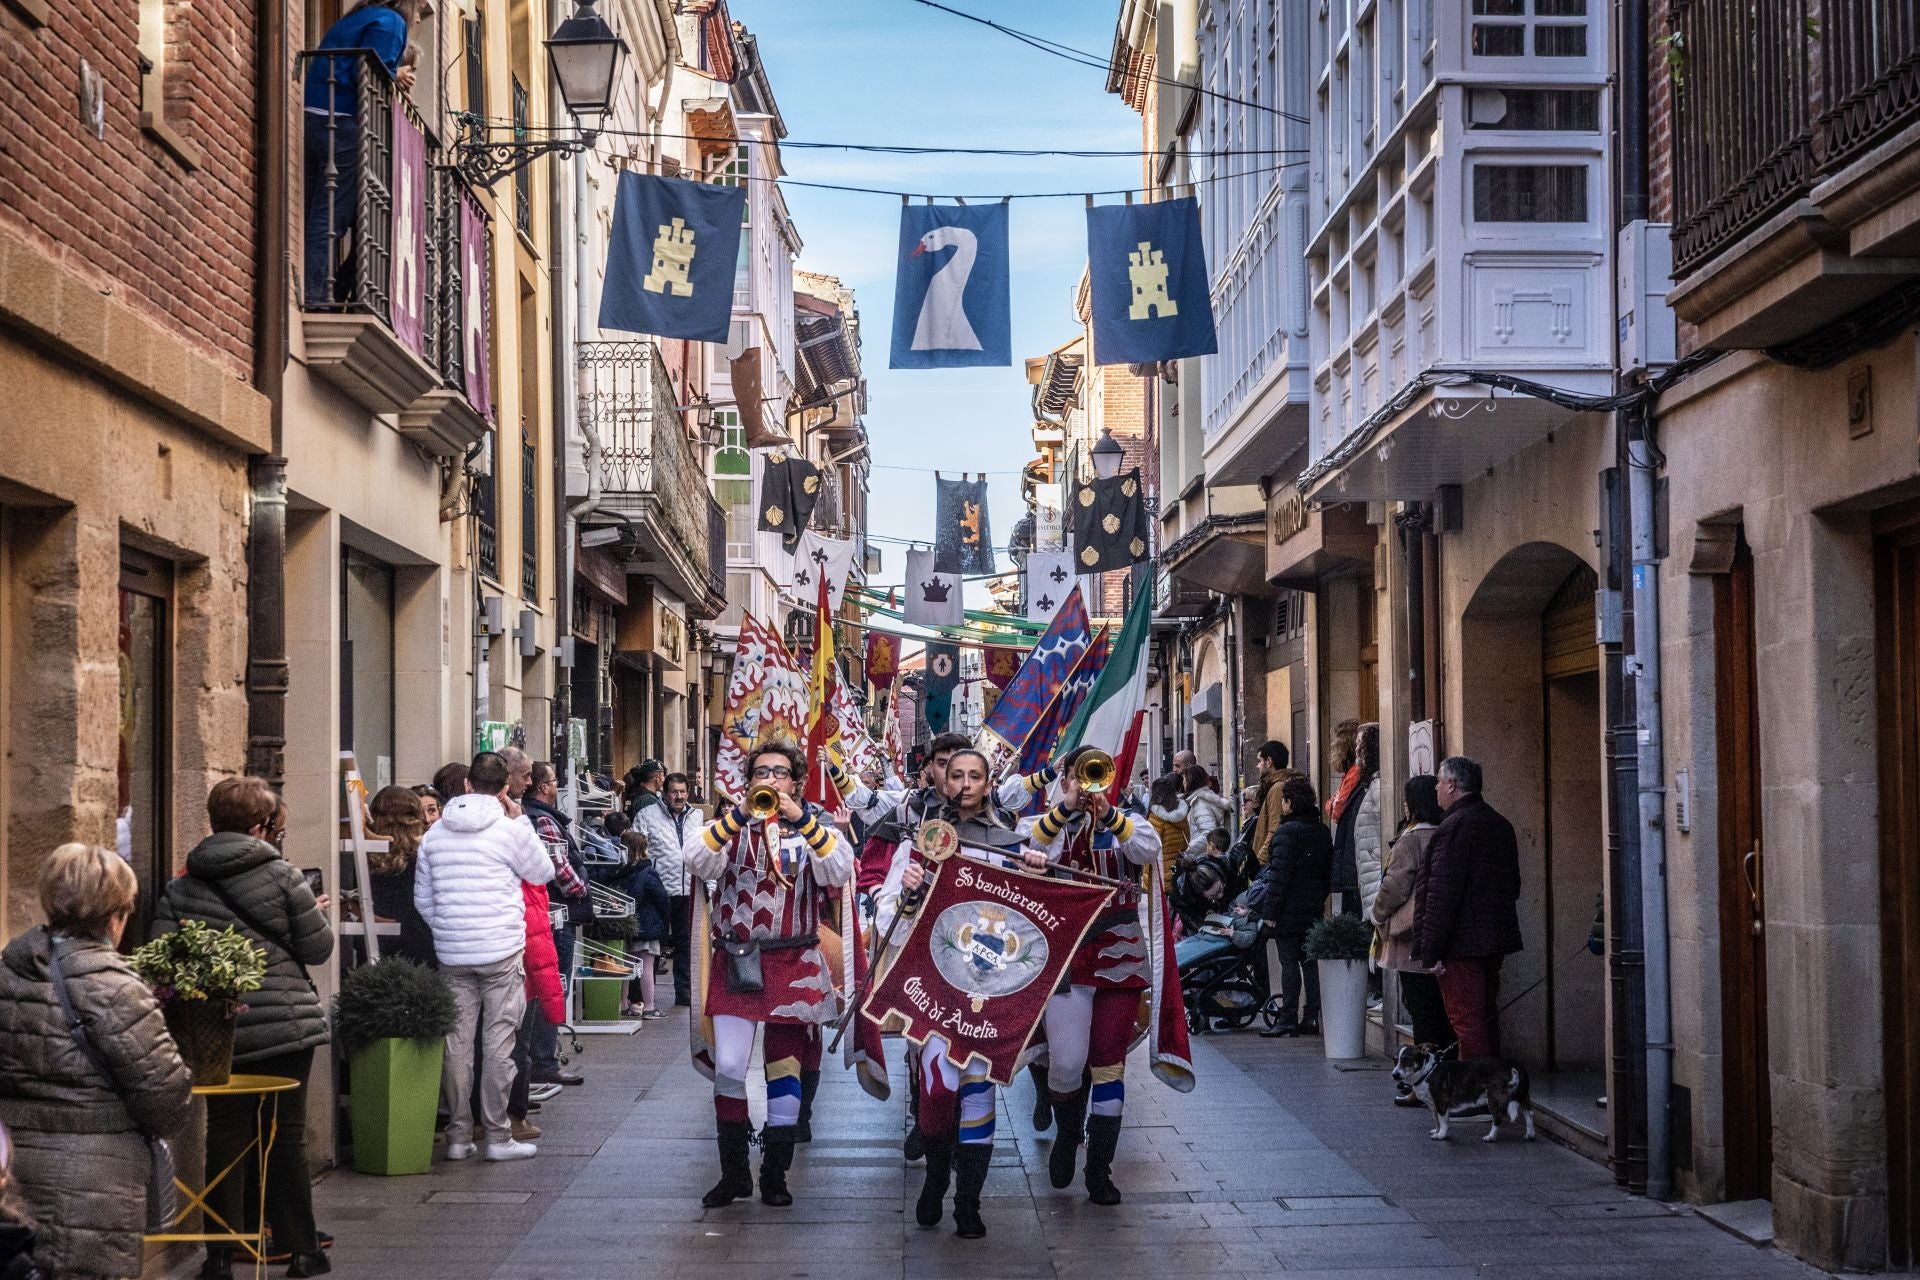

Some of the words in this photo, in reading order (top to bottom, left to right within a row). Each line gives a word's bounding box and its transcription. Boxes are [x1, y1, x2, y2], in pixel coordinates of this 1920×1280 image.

[955, 866, 1066, 931] Sbandieratori
[928, 1000, 947, 1022] di
[941, 1008, 999, 1039] Amelia
